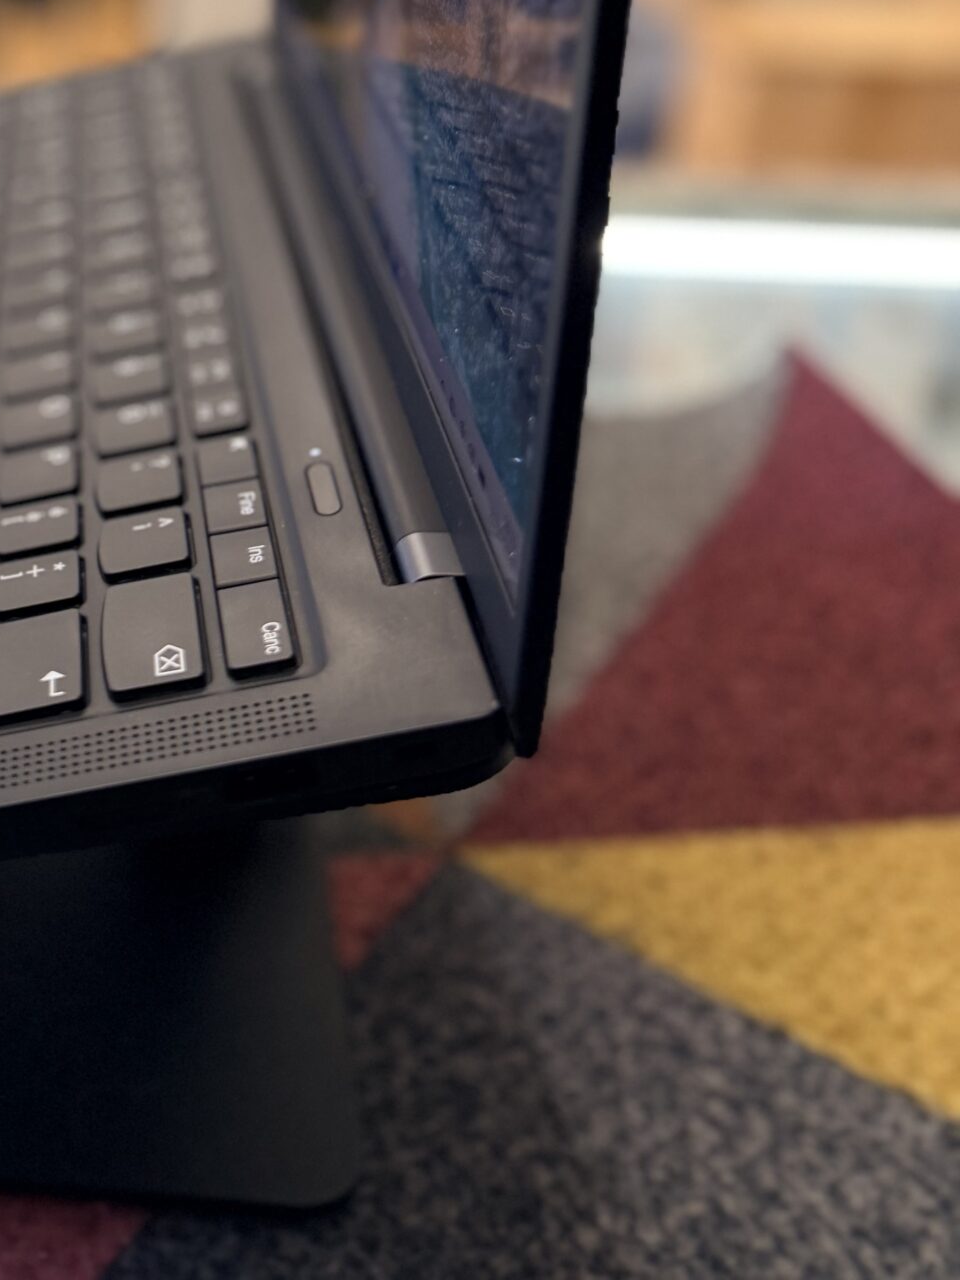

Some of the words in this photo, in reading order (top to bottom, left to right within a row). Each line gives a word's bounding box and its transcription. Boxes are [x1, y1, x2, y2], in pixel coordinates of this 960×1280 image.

[238, 490, 257, 516] Fine
[247, 544, 266, 564] Ins
[260, 620, 282, 656] Canc
